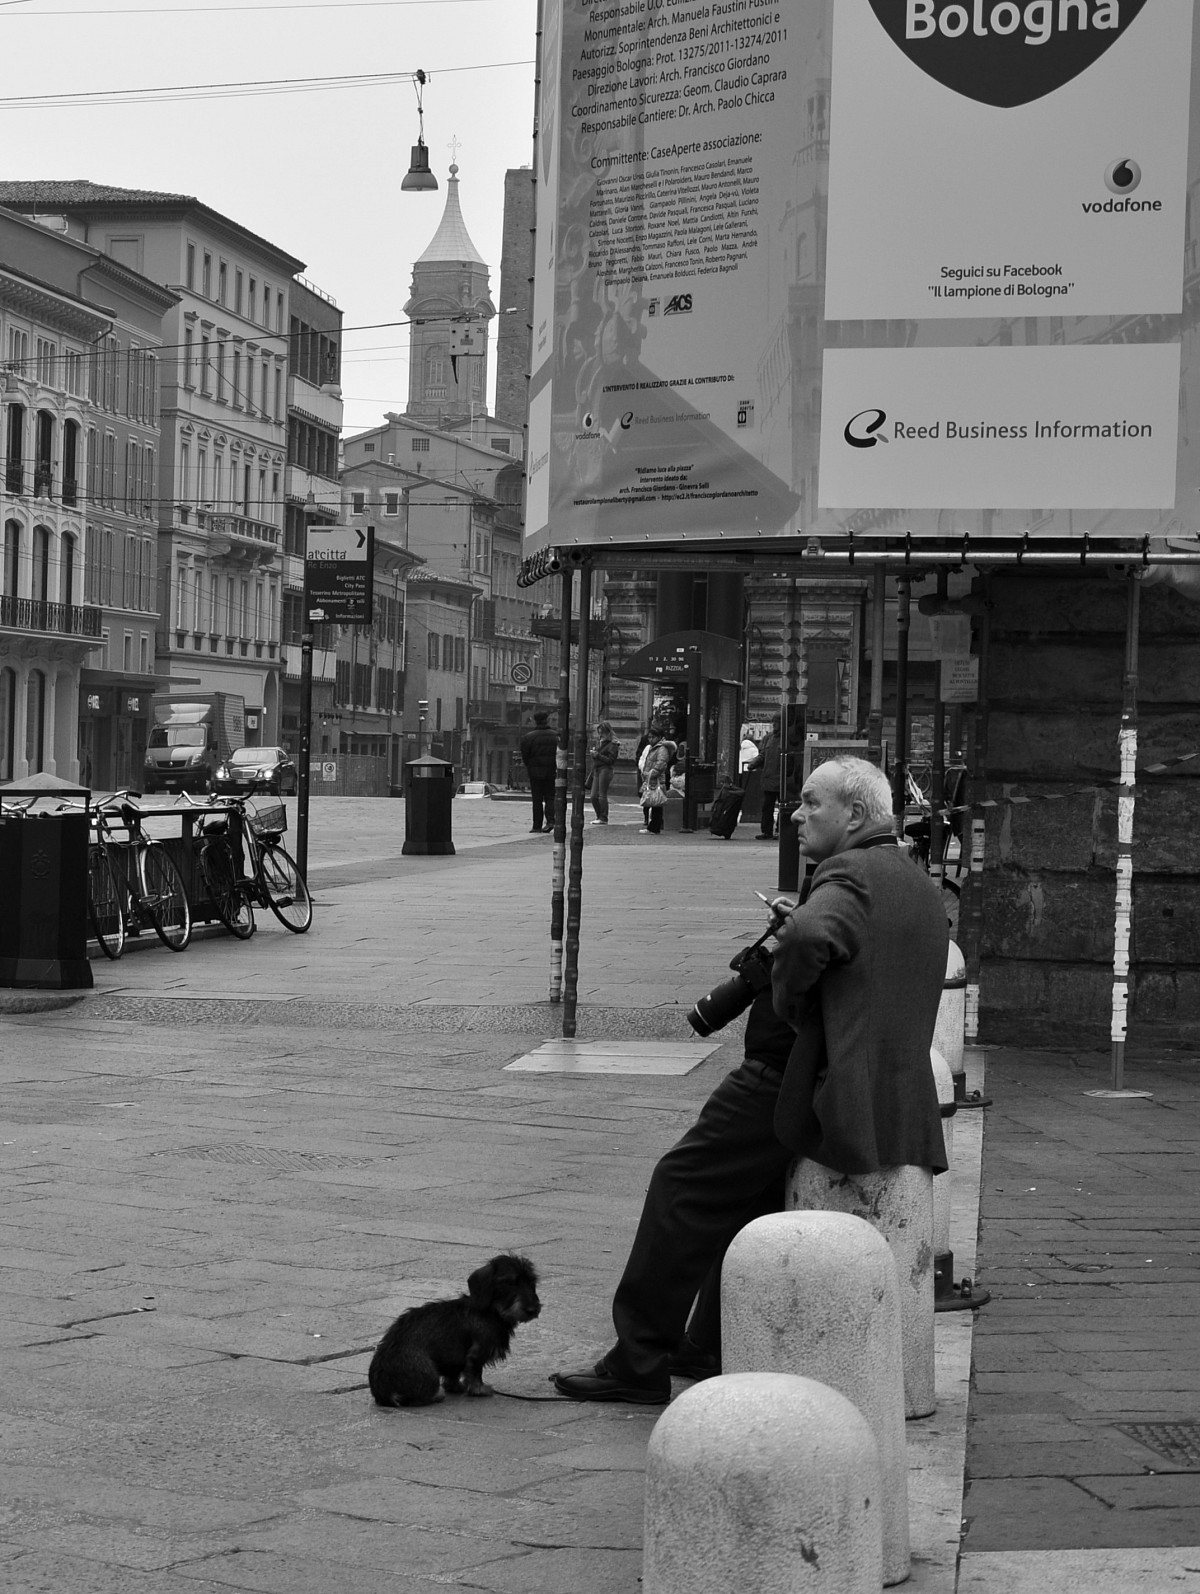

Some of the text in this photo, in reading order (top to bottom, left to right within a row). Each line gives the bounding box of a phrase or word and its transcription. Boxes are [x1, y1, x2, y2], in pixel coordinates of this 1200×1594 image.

[584, 21, 646, 42] Monumentale:
[647, 15, 670, 29] Arch.
[672, 6, 710, 24] Manuela
[712, 0, 747, 16] Faustini
[590, 1, 645, 22] Responsabile
[906, 0, 1120, 46] Bologna
[581, 12, 781, 61] Autorizz. Soprintendenza Beni Architettonici e
[572, 29, 788, 80] Paesaggio Bologna: Prot. 13275/2011-13274/2011
[588, 54, 770, 97] Direzione Lavori: Arch. Francisco Giordano
[571, 70, 787, 118] Coordinamento Sicurezza: Geom. Claudio Caprara
[581, 91, 775, 134] Responsabile Cantiere: Dr. Arch. Paolo Chicca
[591, 133, 762, 169] Committente: CaseAperte associazione:
[681, 164, 705, 173] Francesco
[727, 156, 753, 166] Emanuele
[1081, 197, 1162, 213] vodafone
[940, 264, 1063, 281] Seguici su Facebook
[944, 284, 1002, 299] lampione
[1003, 283, 1015, 296] di
[1017, 282, 1075, 297] Bologna"
[602, 384, 636, 393] L'INTERVENTO
[640, 380, 669, 390] REALIZZATO
[669, 379, 687, 387] GRAZIE
[687, 378, 695, 386] AL
[695, 375, 727, 385] CONTRIBUTO
[575, 412, 711, 441] vodafone Reed Business Information
[894, 420, 1153, 439] Reed Business Information
